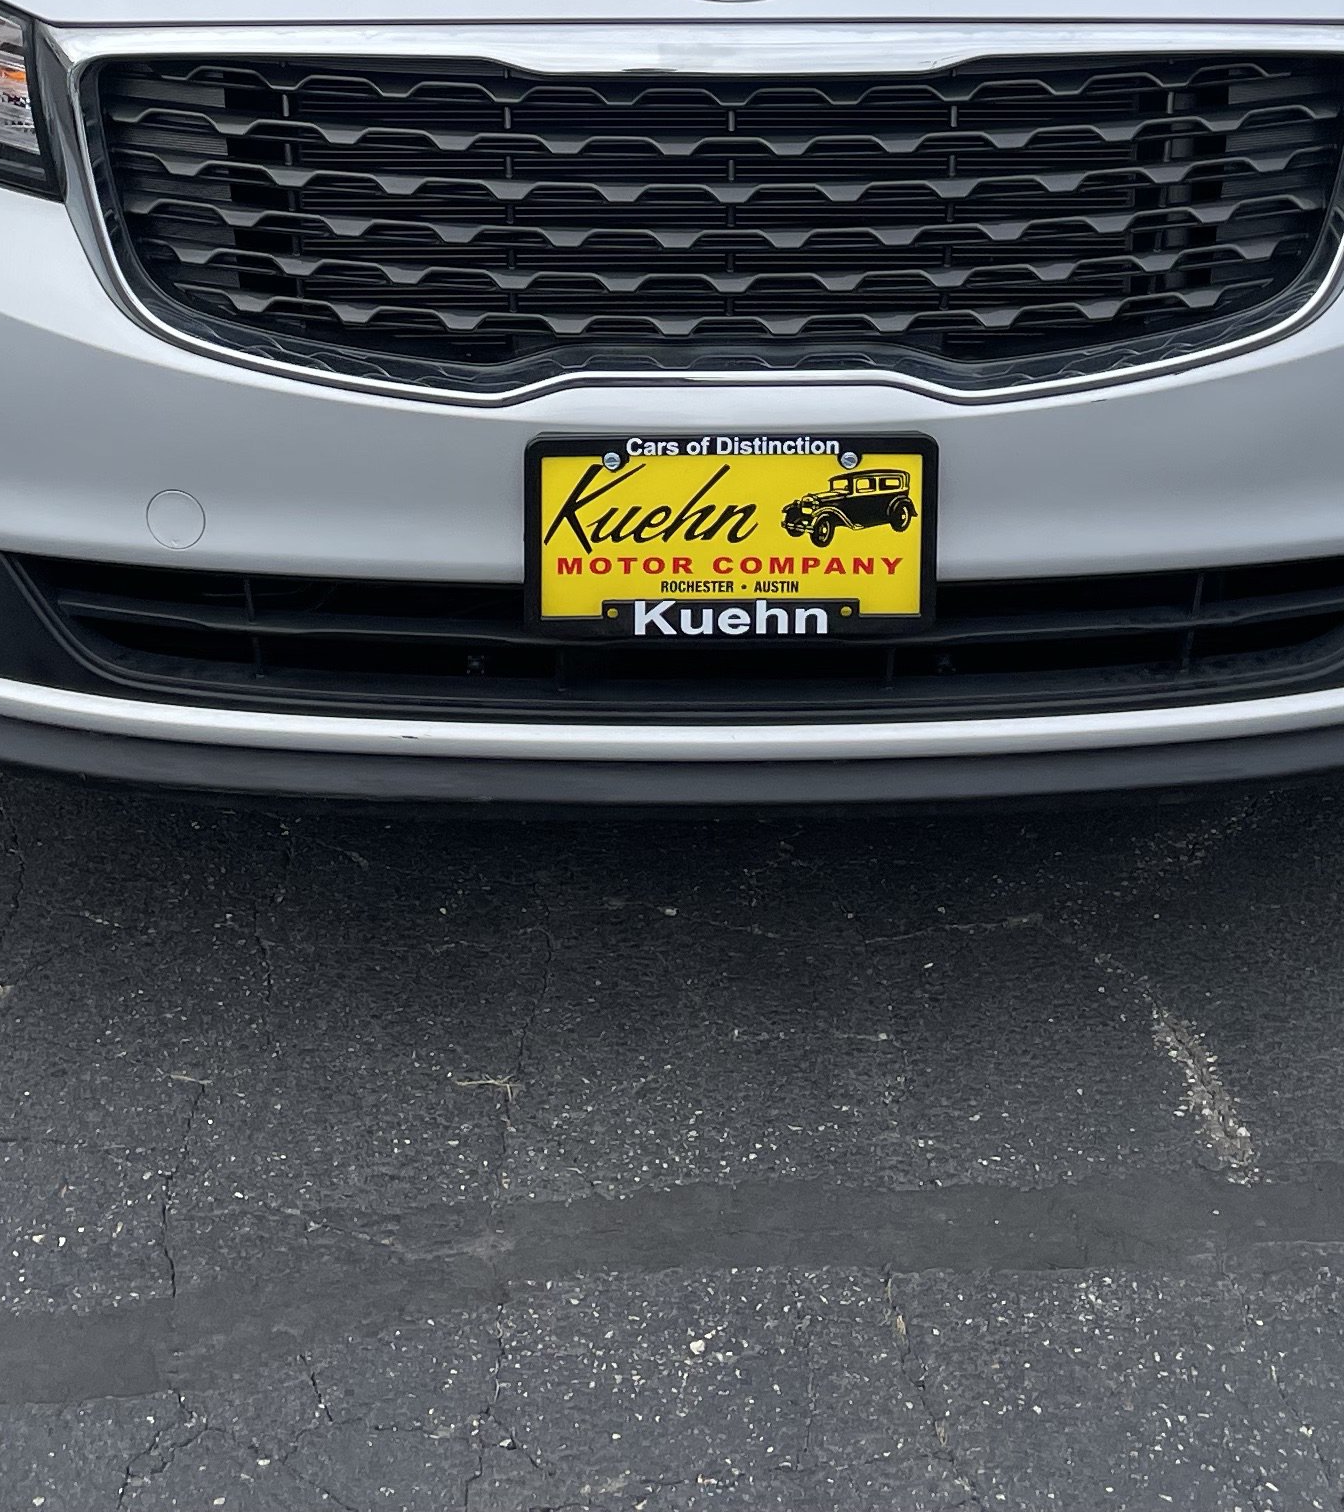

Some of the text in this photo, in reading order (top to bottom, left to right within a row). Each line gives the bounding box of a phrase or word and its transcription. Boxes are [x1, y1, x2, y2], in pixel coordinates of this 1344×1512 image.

[625, 436, 840, 457] Cars of Distinction
[543, 462, 759, 555] Kuehn
[556, 556, 904, 576] MOTOR COMPANY
[660, 581, 800, 594] ROCHESTER AUSTIN
[634, 599, 829, 636] Kuehn
